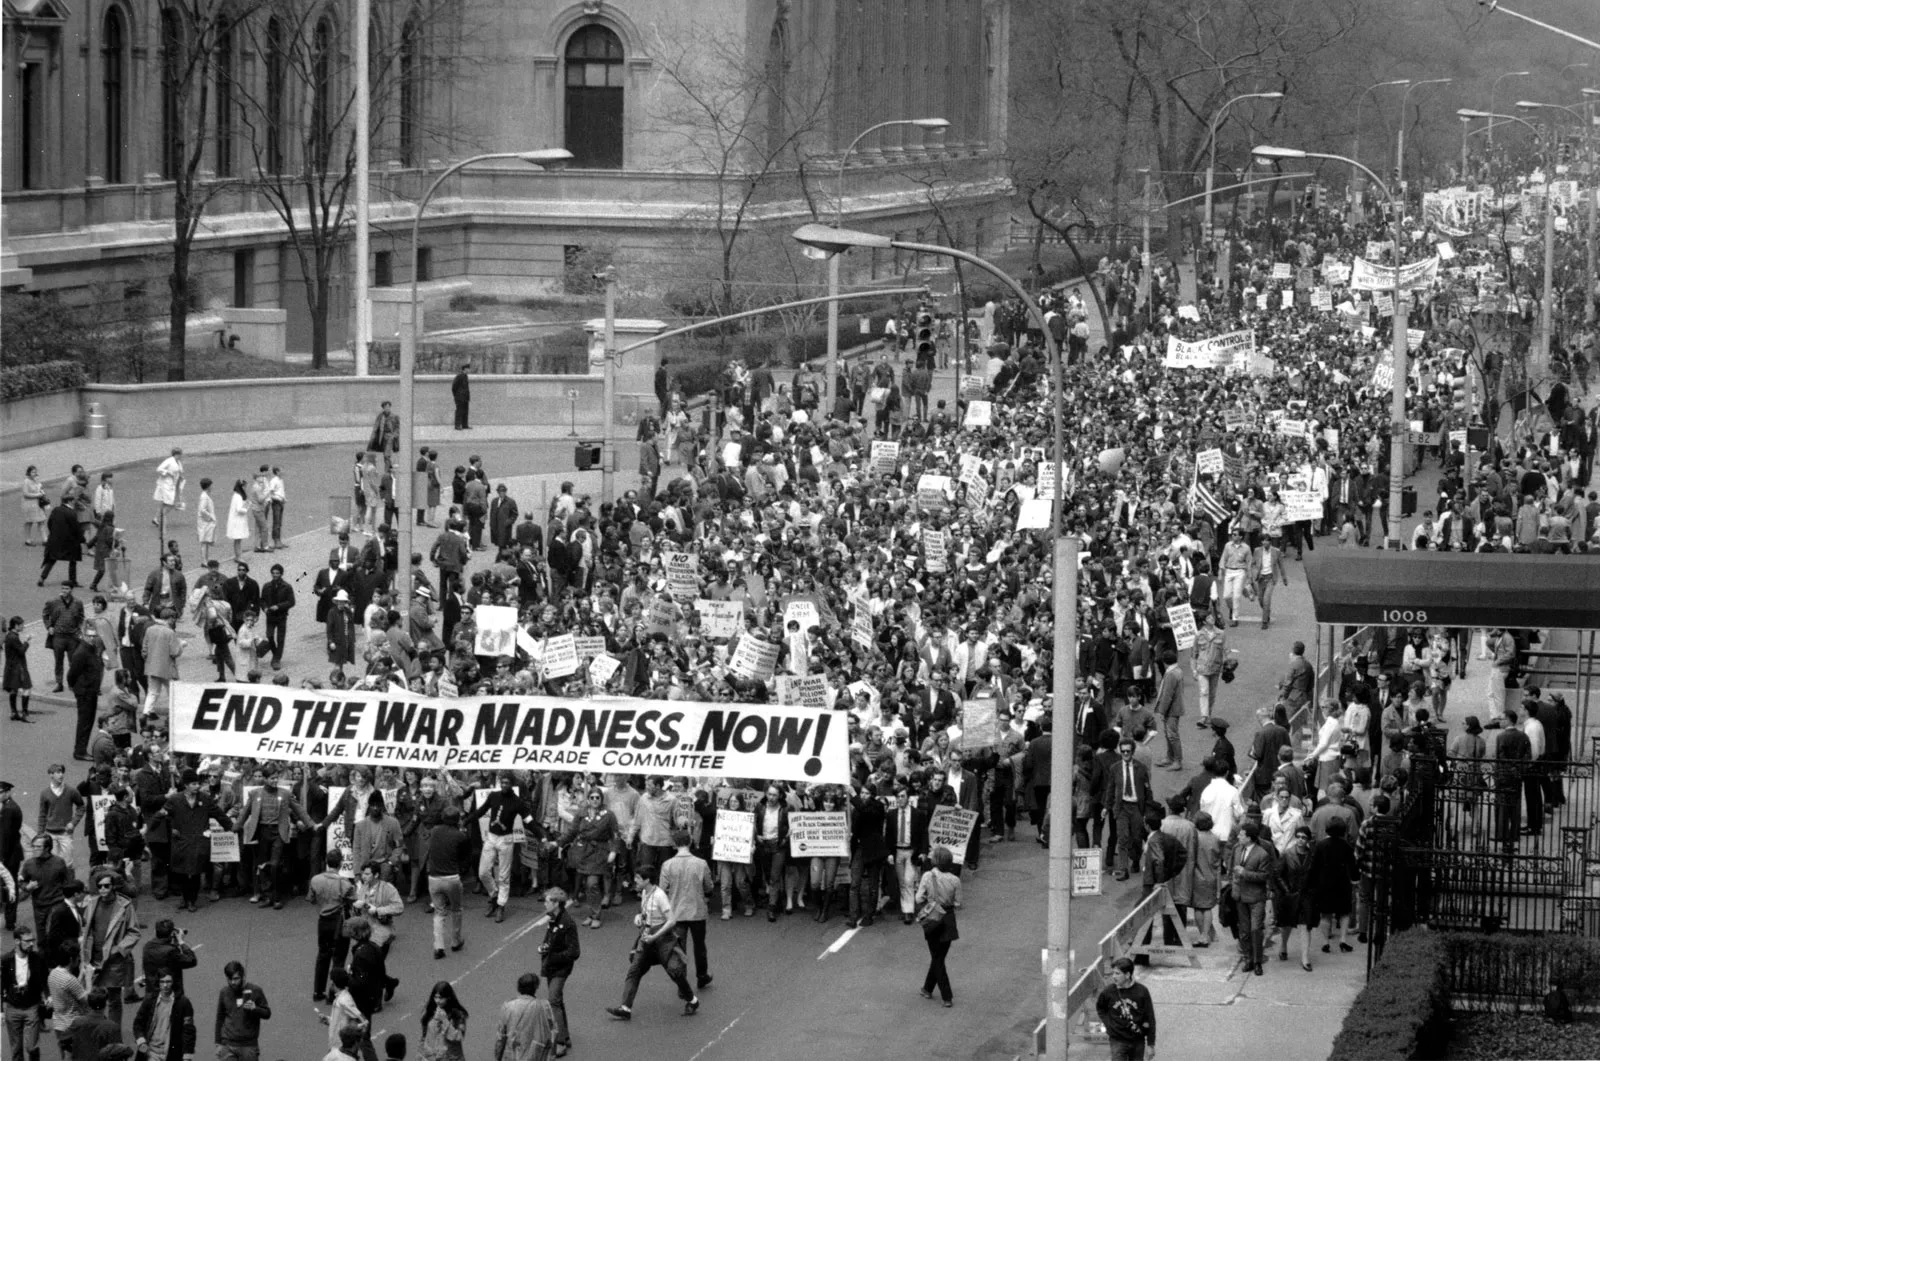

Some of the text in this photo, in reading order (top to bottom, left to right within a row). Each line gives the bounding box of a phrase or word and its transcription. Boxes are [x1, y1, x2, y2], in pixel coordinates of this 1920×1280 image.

[1408, 433, 1431, 443] E 82
[671, 554, 689, 563] NO
[791, 610, 810, 618] SAM
[1383, 610, 1428, 622] 1008
[803, 678, 821, 686] WAR
[191, 688, 283, 735] END
[290, 699, 367, 740] THE
[372, 700, 464, 747] WAR
[256, 737, 726, 770] FIFTH AVE. VIETNAM PEACE PARADE COMMITTEE
[1072, 857, 1087, 869] NO
